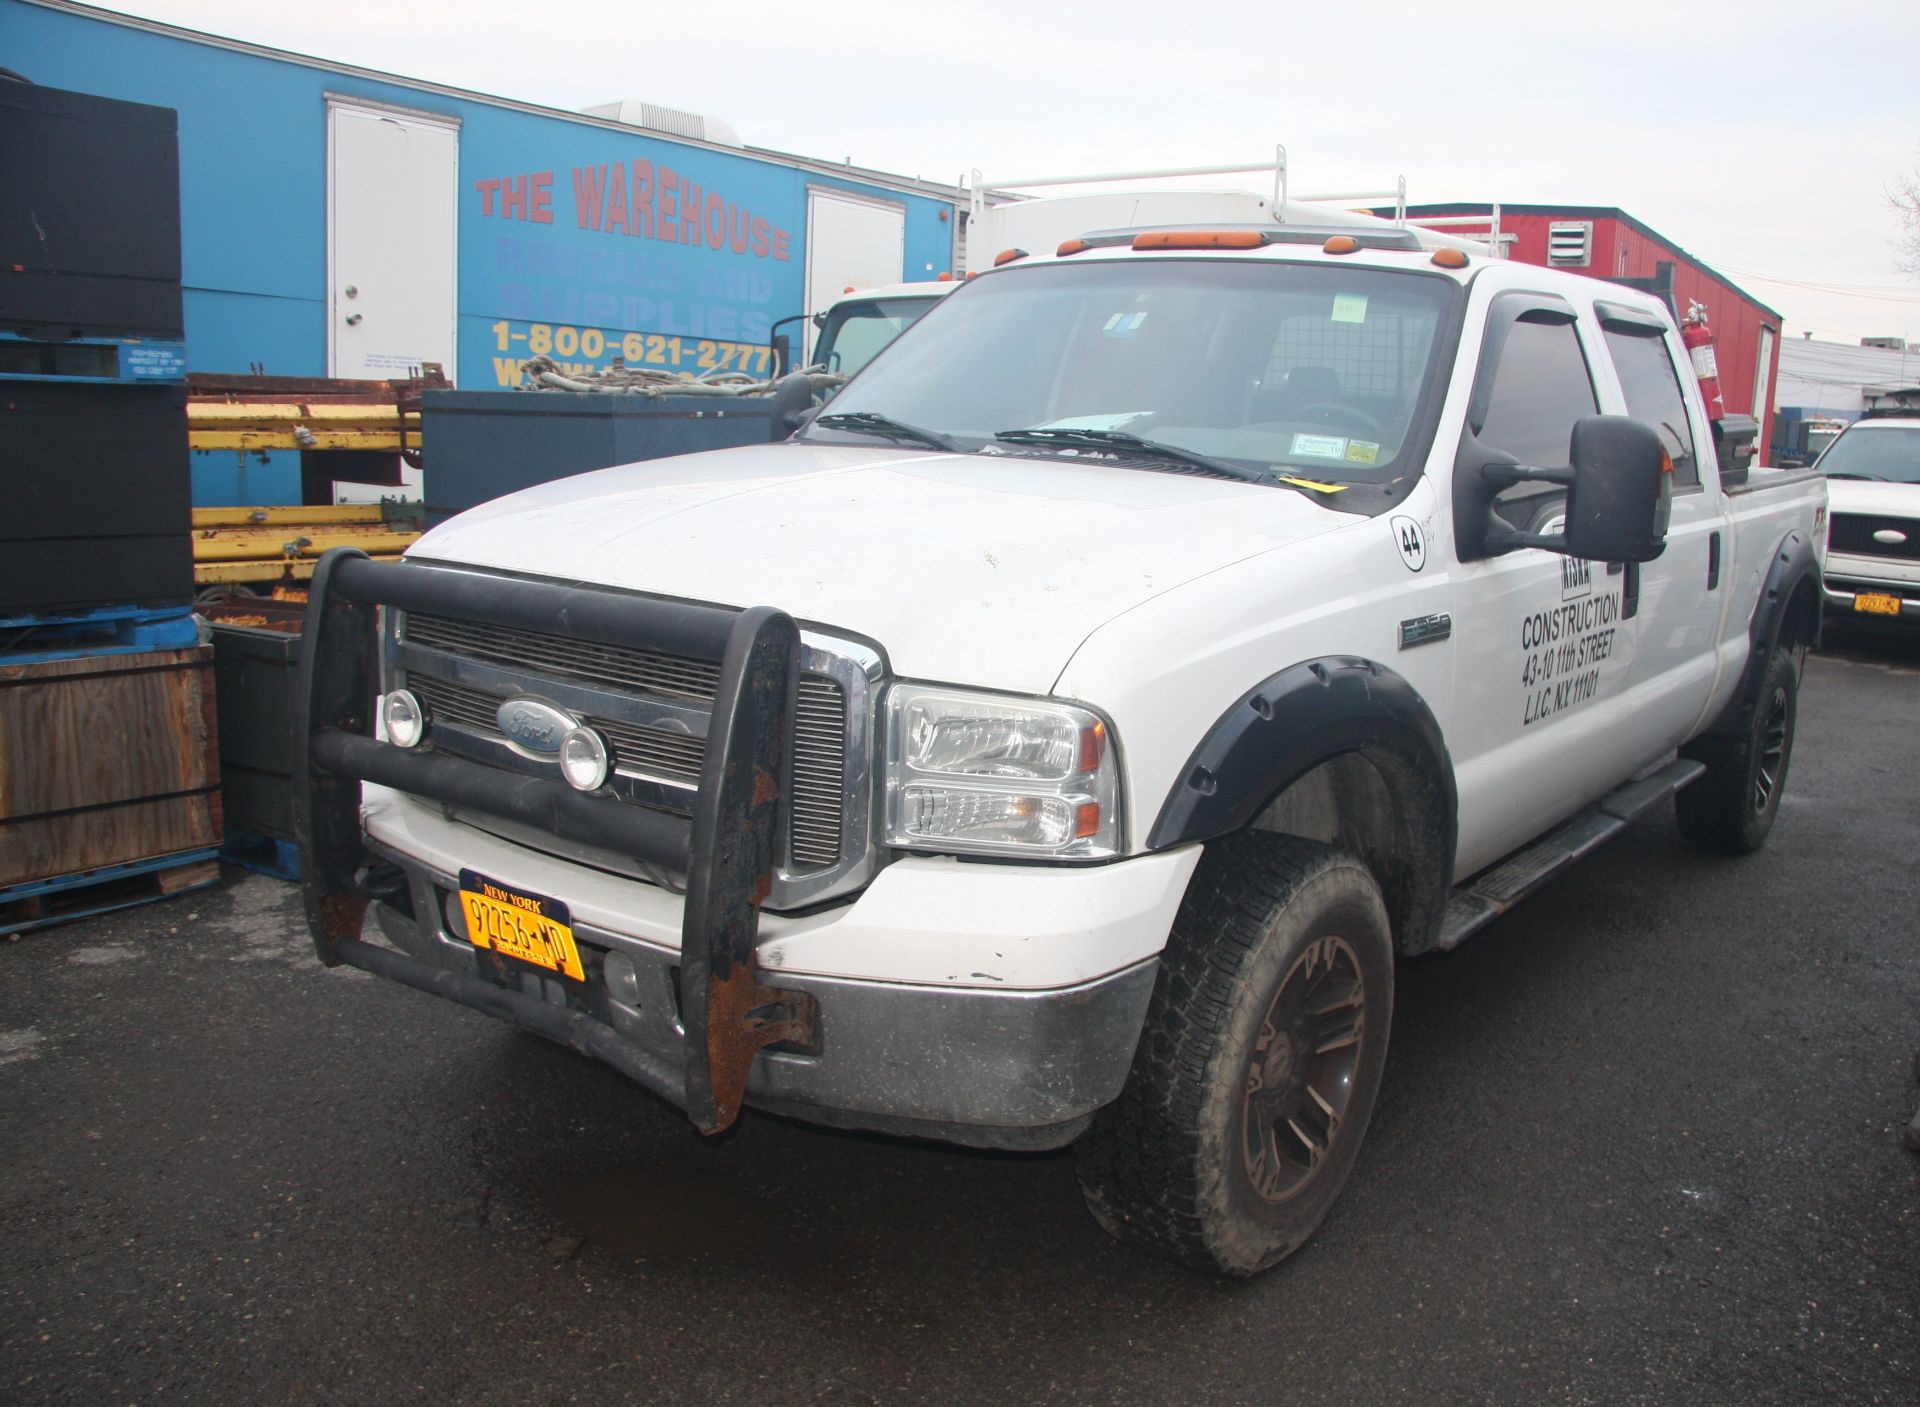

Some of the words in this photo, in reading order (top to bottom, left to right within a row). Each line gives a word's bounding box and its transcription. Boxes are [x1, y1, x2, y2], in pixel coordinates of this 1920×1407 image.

[475, 171, 553, 224] THE
[572, 159, 791, 261] WAREHOUSE
[496, 234, 680, 294] RENTALS
[698, 262, 773, 305] AND
[496, 281, 771, 343] SUPPLIES
[492, 320, 771, 373] 1-800-621-2777
[1401, 524, 1420, 557] 44
[1522, 592, 1618, 650] CONSTRUCTION
[1522, 648, 1554, 688] 43-10
[1556, 641, 1576, 676] 11th
[1577, 628, 1615, 668] STREET
[1573, 667, 1599, 704] 11101
[510, 708, 554, 745] Ford
[484, 883, 509, 902] NEW
[510, 894, 541, 914] YORK
